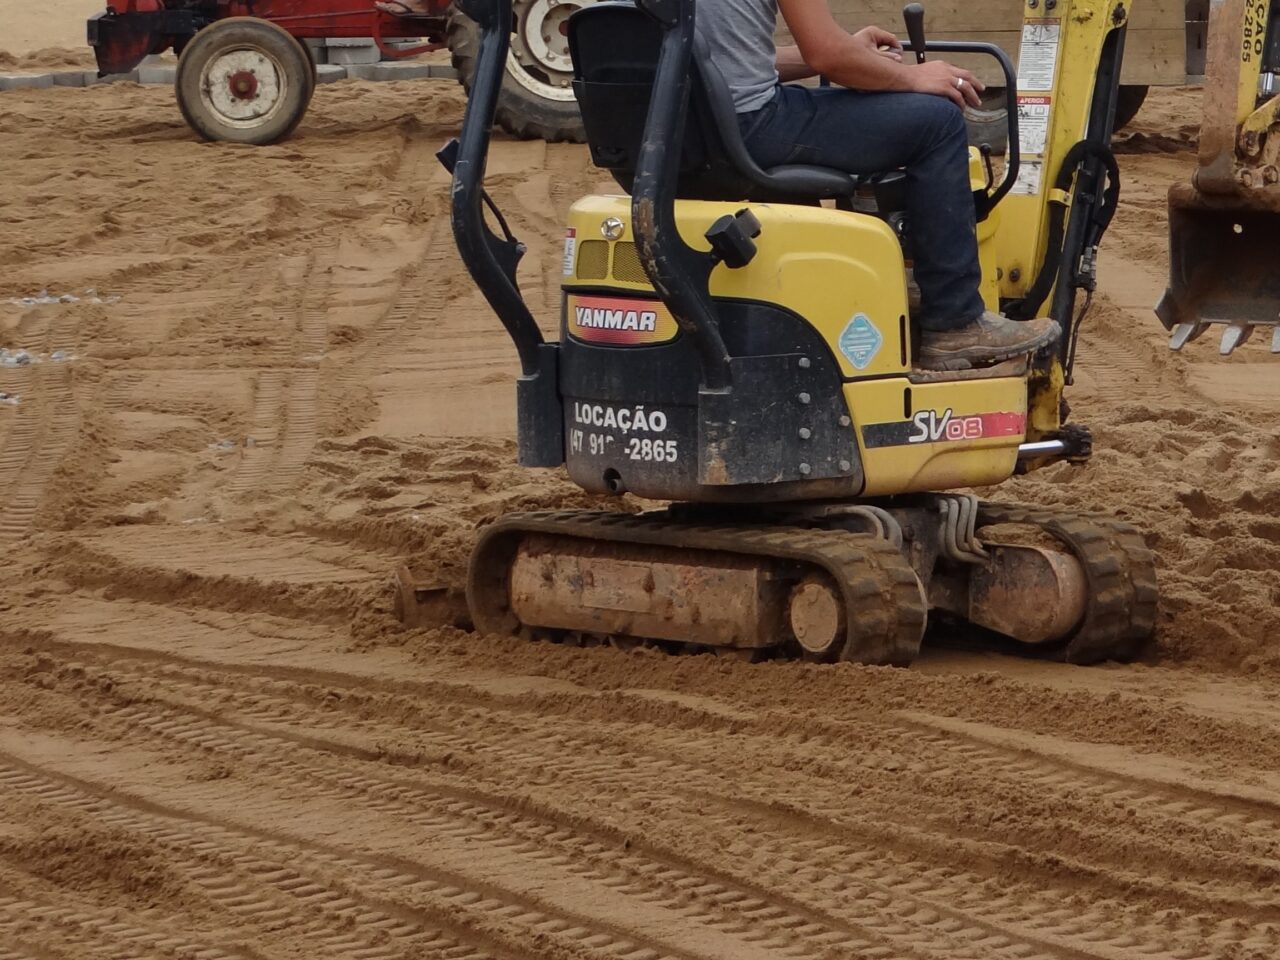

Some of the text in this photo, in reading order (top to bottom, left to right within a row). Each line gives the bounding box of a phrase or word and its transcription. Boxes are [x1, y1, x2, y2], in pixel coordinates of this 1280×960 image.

[575, 306, 657, 331] YANMAR
[574, 402, 667, 434] LOCAÇÃO
[908, 408, 982, 442] SV08
